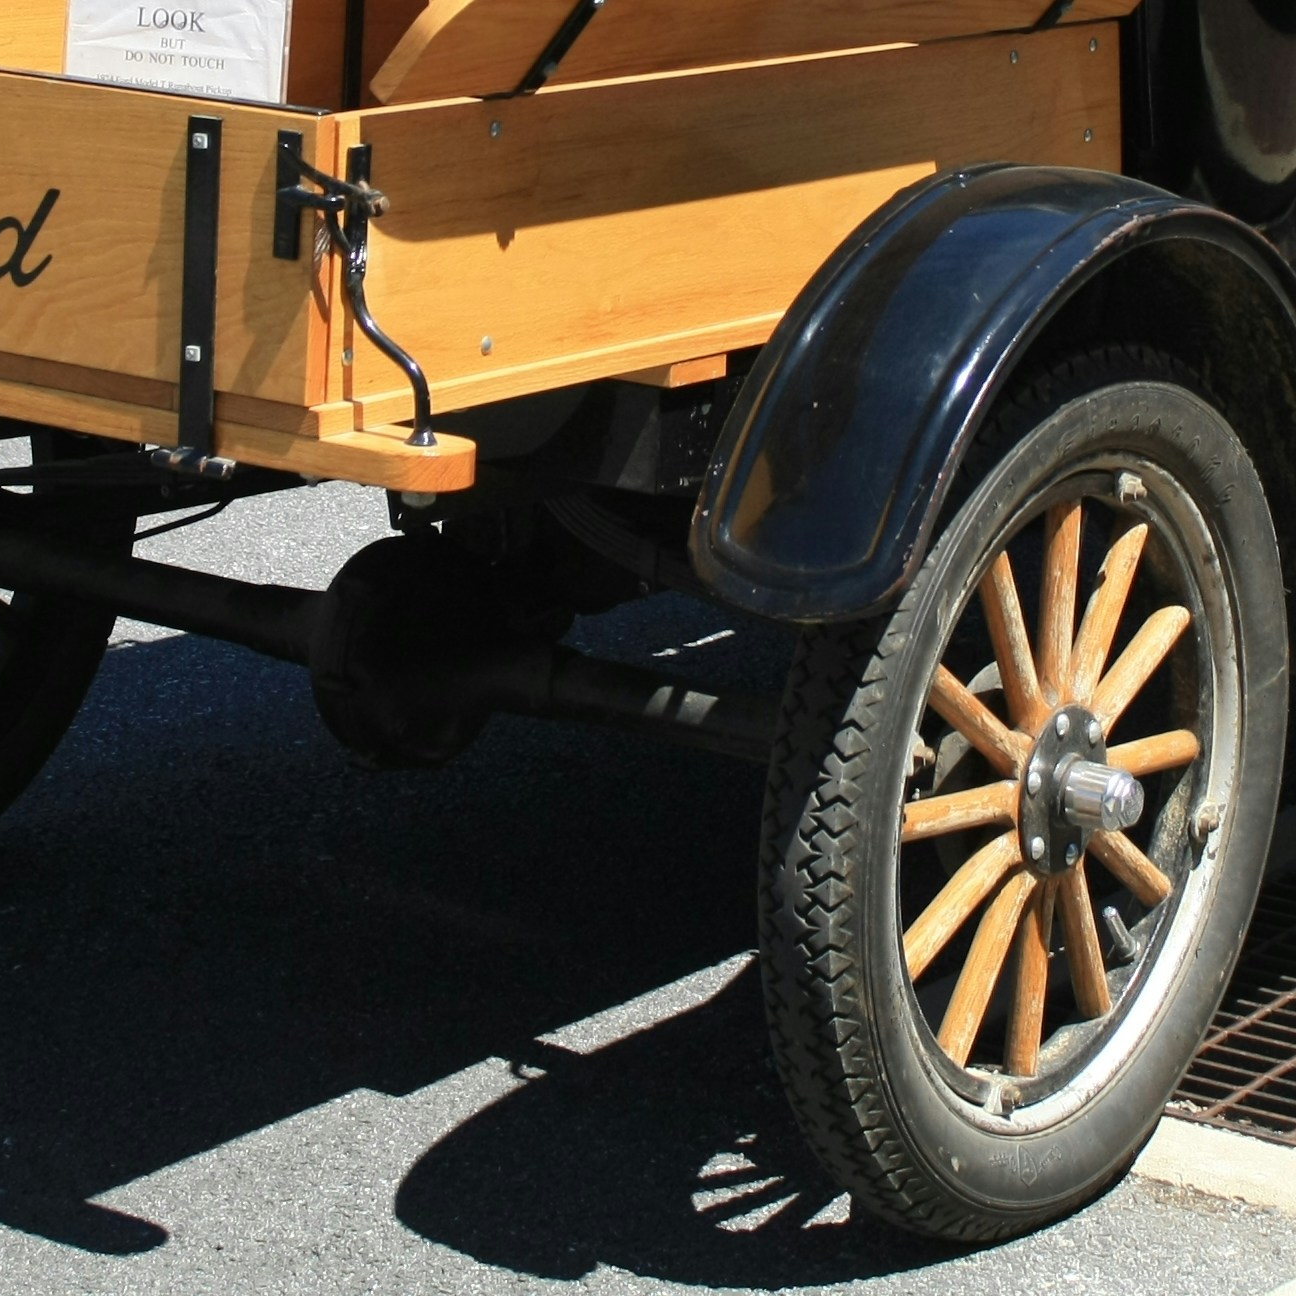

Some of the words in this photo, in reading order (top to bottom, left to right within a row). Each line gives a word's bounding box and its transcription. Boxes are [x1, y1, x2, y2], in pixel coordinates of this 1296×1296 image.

[137, 6, 206, 33] LOOK
[160, 37, 187, 51] BUT
[124, 50, 143, 63] DO
[149, 52, 176, 66] NOT
[181, 55, 226, 71] TOUCH
